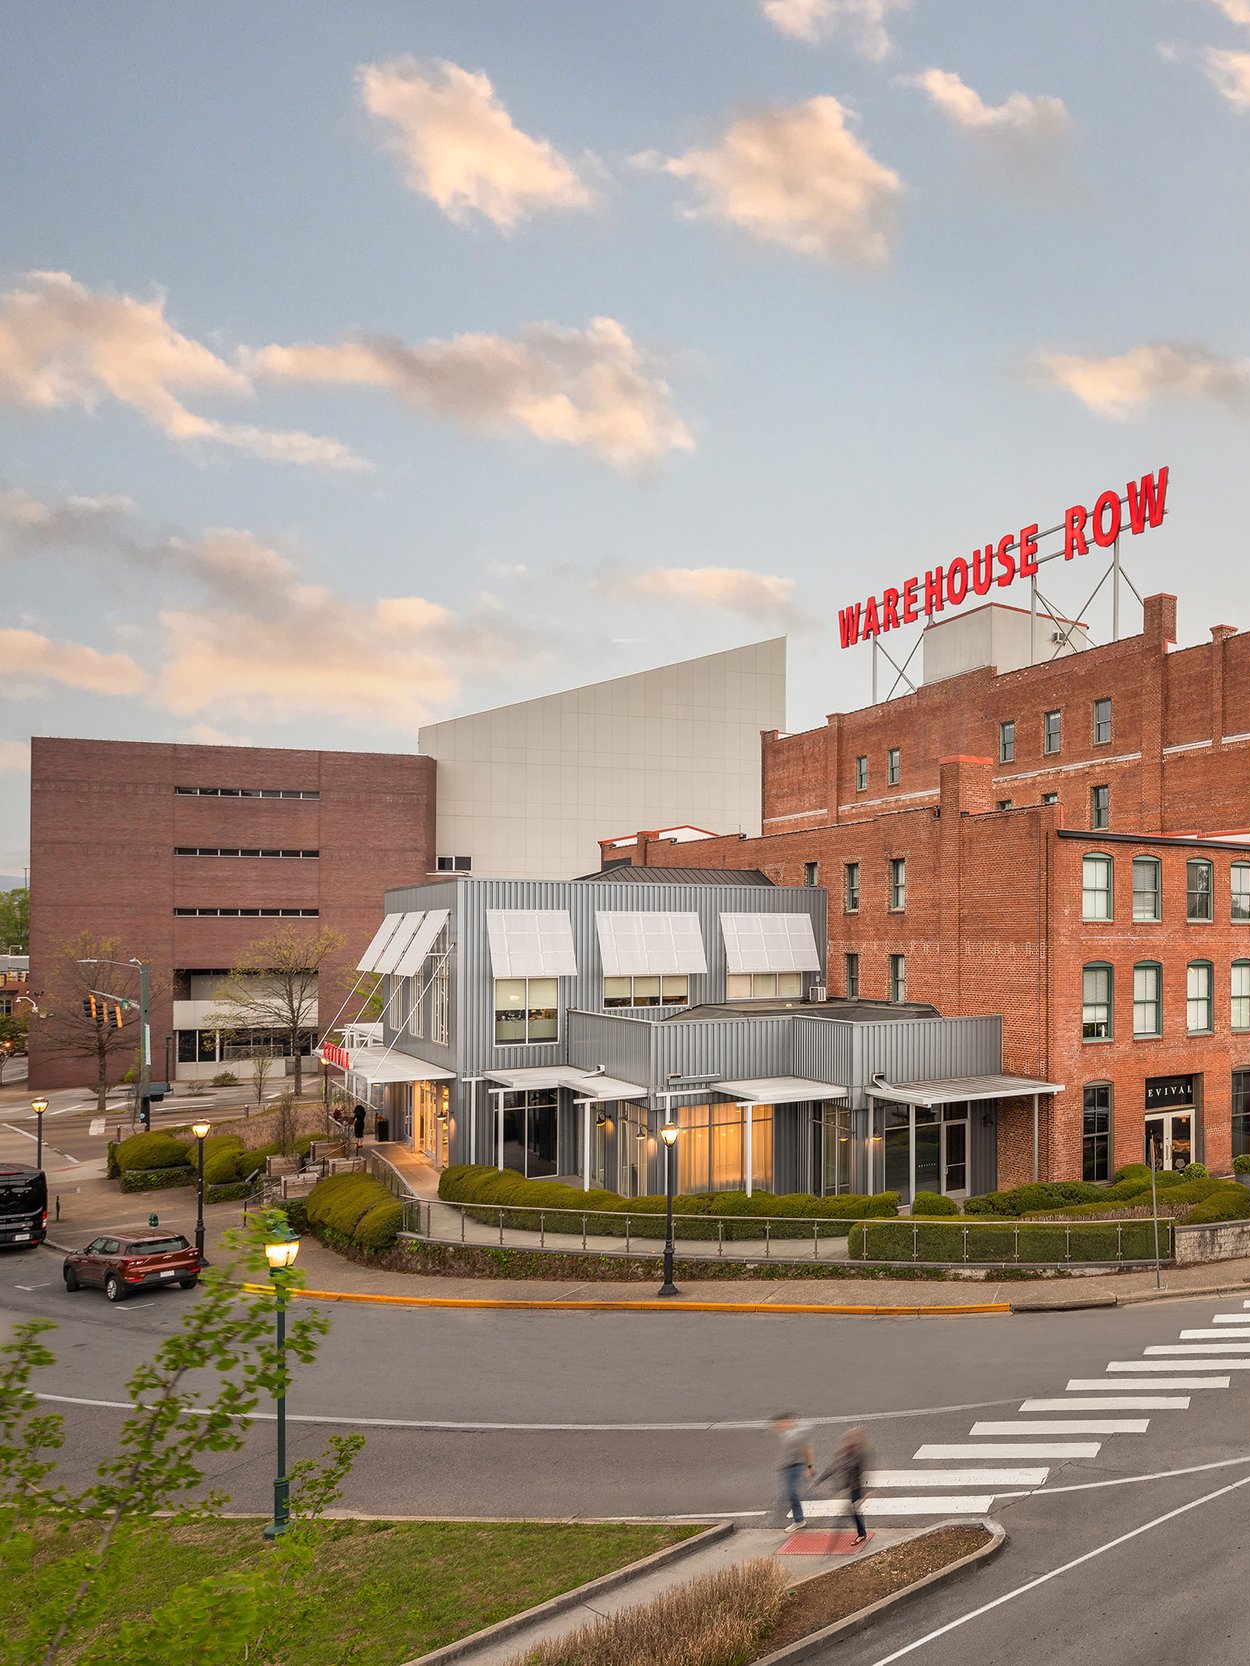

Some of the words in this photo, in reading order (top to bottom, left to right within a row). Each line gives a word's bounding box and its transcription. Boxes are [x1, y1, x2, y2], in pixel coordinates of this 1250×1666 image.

[838, 523, 1039, 649] WAREHOUSE
[1064, 466, 1170, 561] ROW
[1148, 1085, 1193, 1097] EVIVAL
